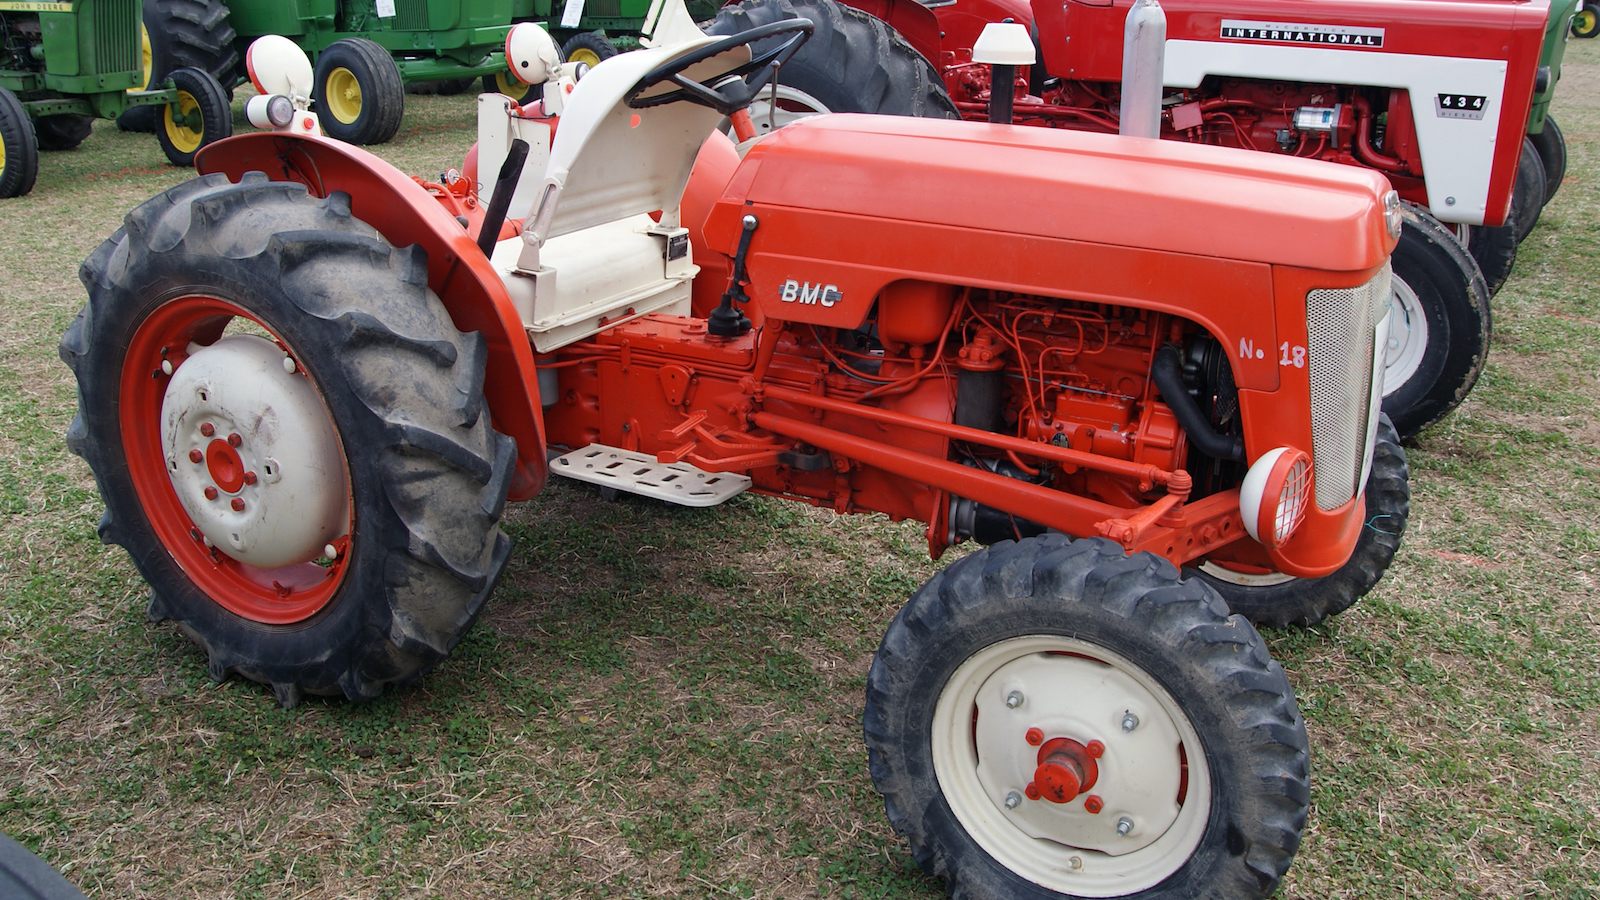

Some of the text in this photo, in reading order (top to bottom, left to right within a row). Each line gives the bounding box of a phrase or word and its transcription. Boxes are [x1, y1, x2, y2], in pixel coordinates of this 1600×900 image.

[1228, 28, 1375, 45] INTERNATIONAL
[1442, 96, 1481, 109] 434
[1441, 111, 1480, 119] DIESEL
[781, 279, 838, 307] BMC
[1279, 341, 1306, 368] 18
